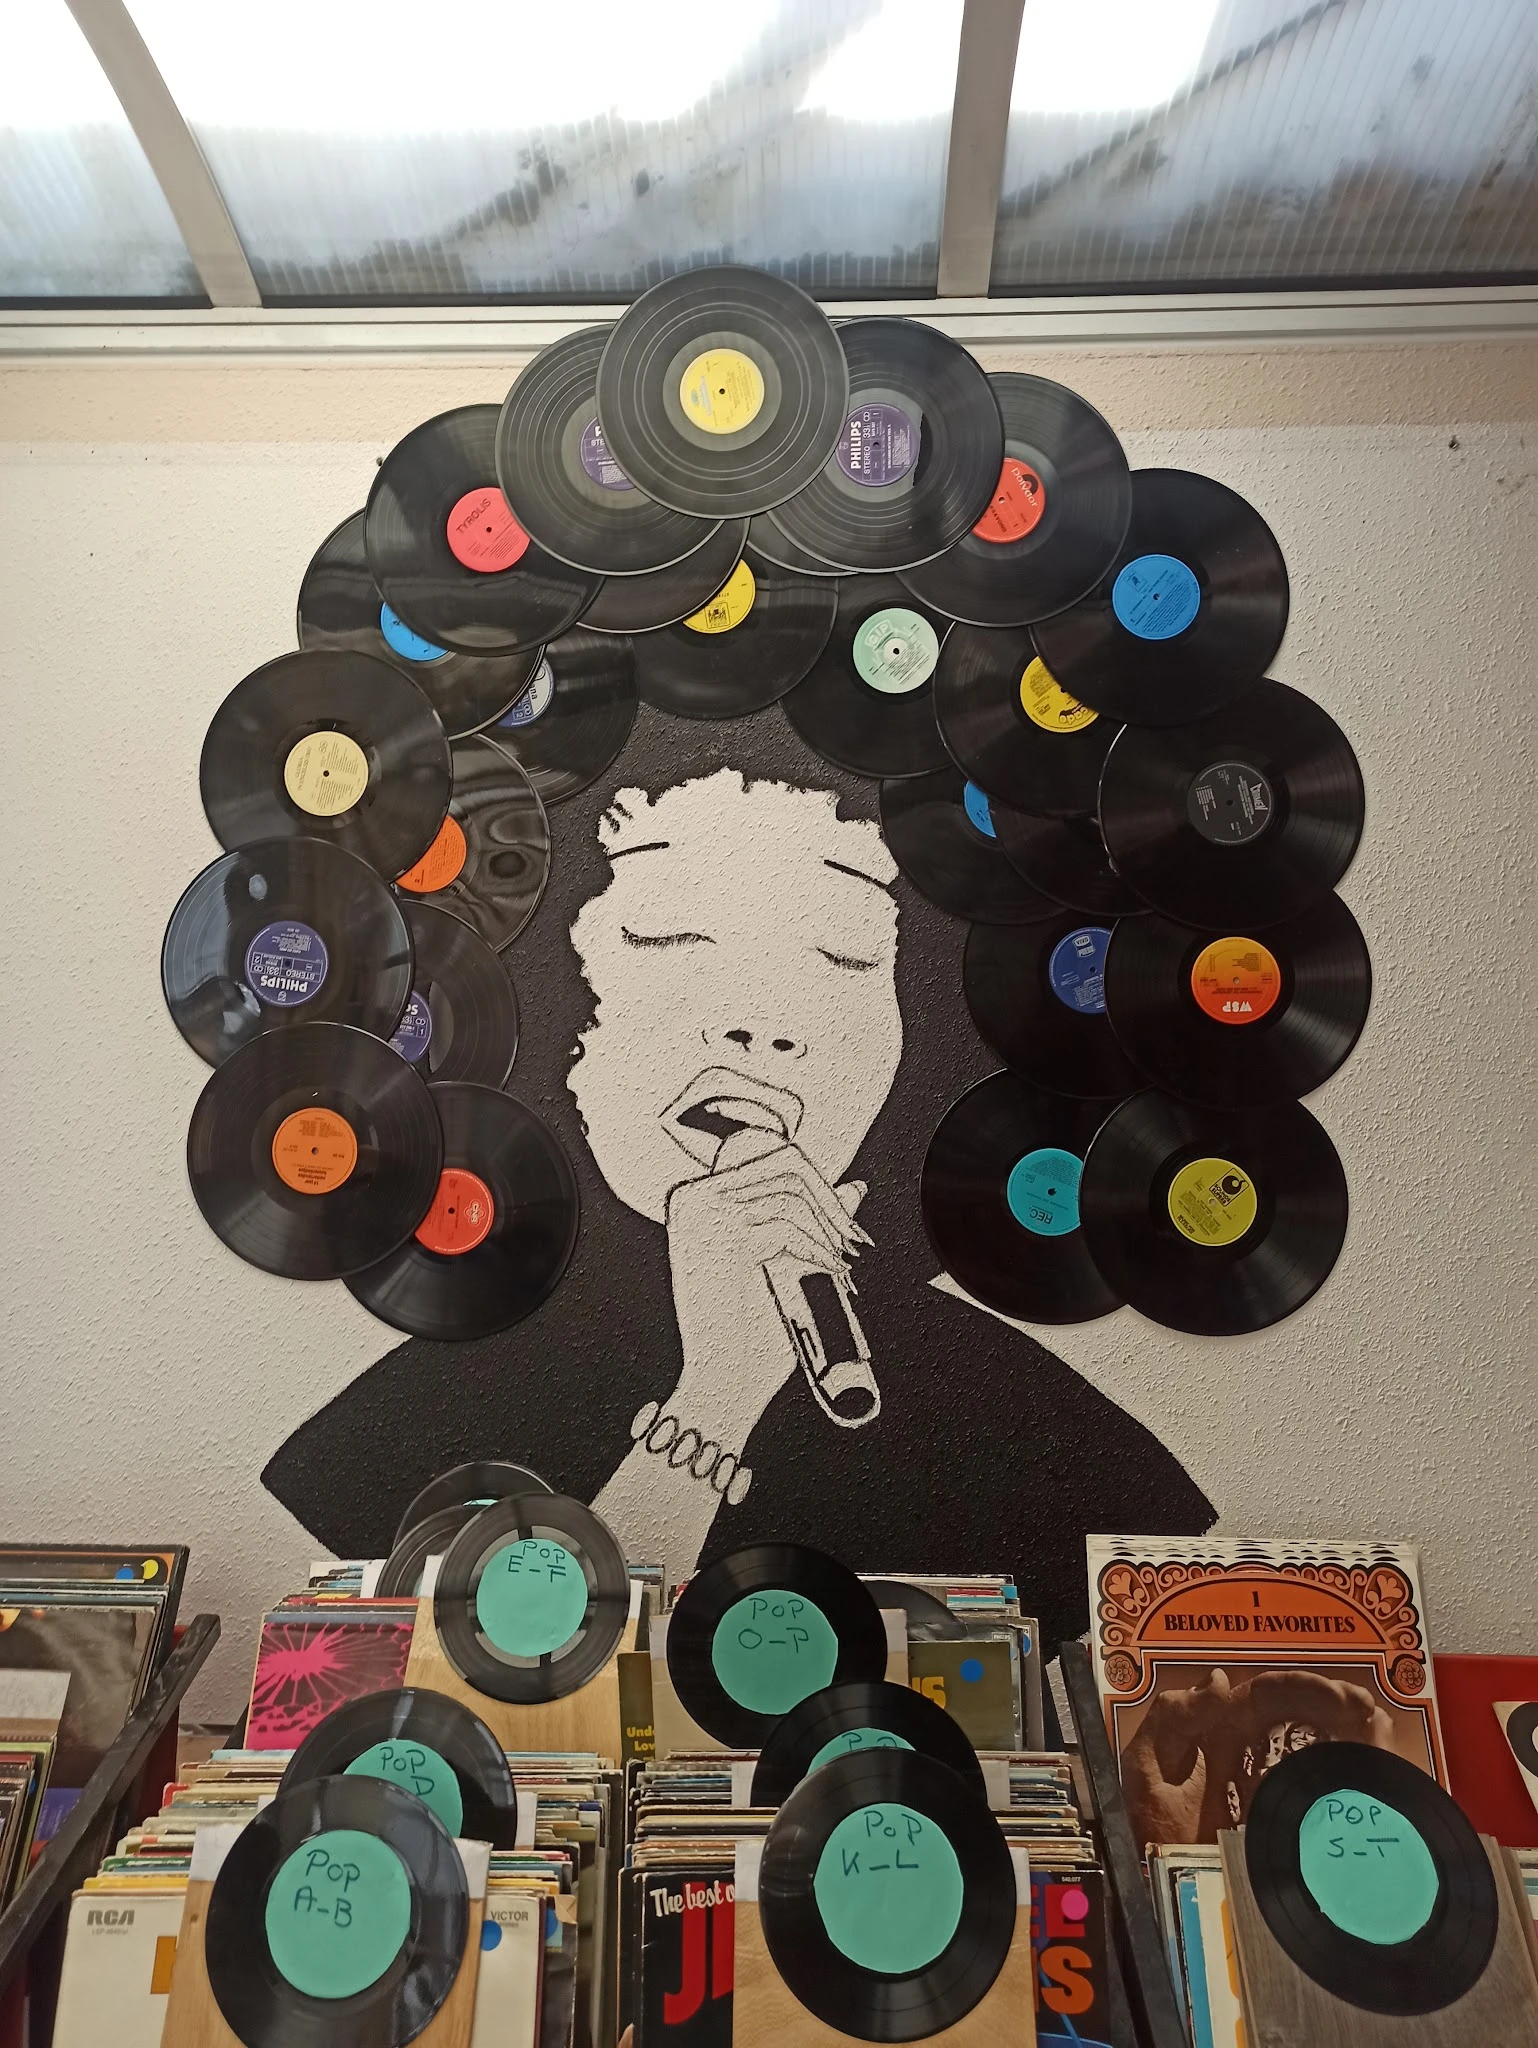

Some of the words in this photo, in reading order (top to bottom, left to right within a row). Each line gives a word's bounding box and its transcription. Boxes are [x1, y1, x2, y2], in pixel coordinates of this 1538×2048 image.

[591, 438, 605, 446] STE
[850, 420, 862, 470] PHILIPS
[863, 446, 871, 474] STEREO
[1010, 467, 1038, 508] polydor
[456, 498, 491, 534] TYROLIS
[286, 968, 316, 980] STEREO
[260, 975, 308, 992] PHILIPS
[1222, 1001, 1252, 1012] WSP
[1164, 1614, 1249, 1632] BELOVED
[1253, 1615, 1356, 1633] FAVORITES
[626, 1725, 654, 1737] Und
[634, 1741, 655, 1751] Lov
[649, 1887, 685, 1917] The
[685, 1880, 724, 1911] best
[725, 1884, 736, 1902] o
[87, 1909, 135, 1926] RCA
[490, 1910, 529, 1921] VICTOR
